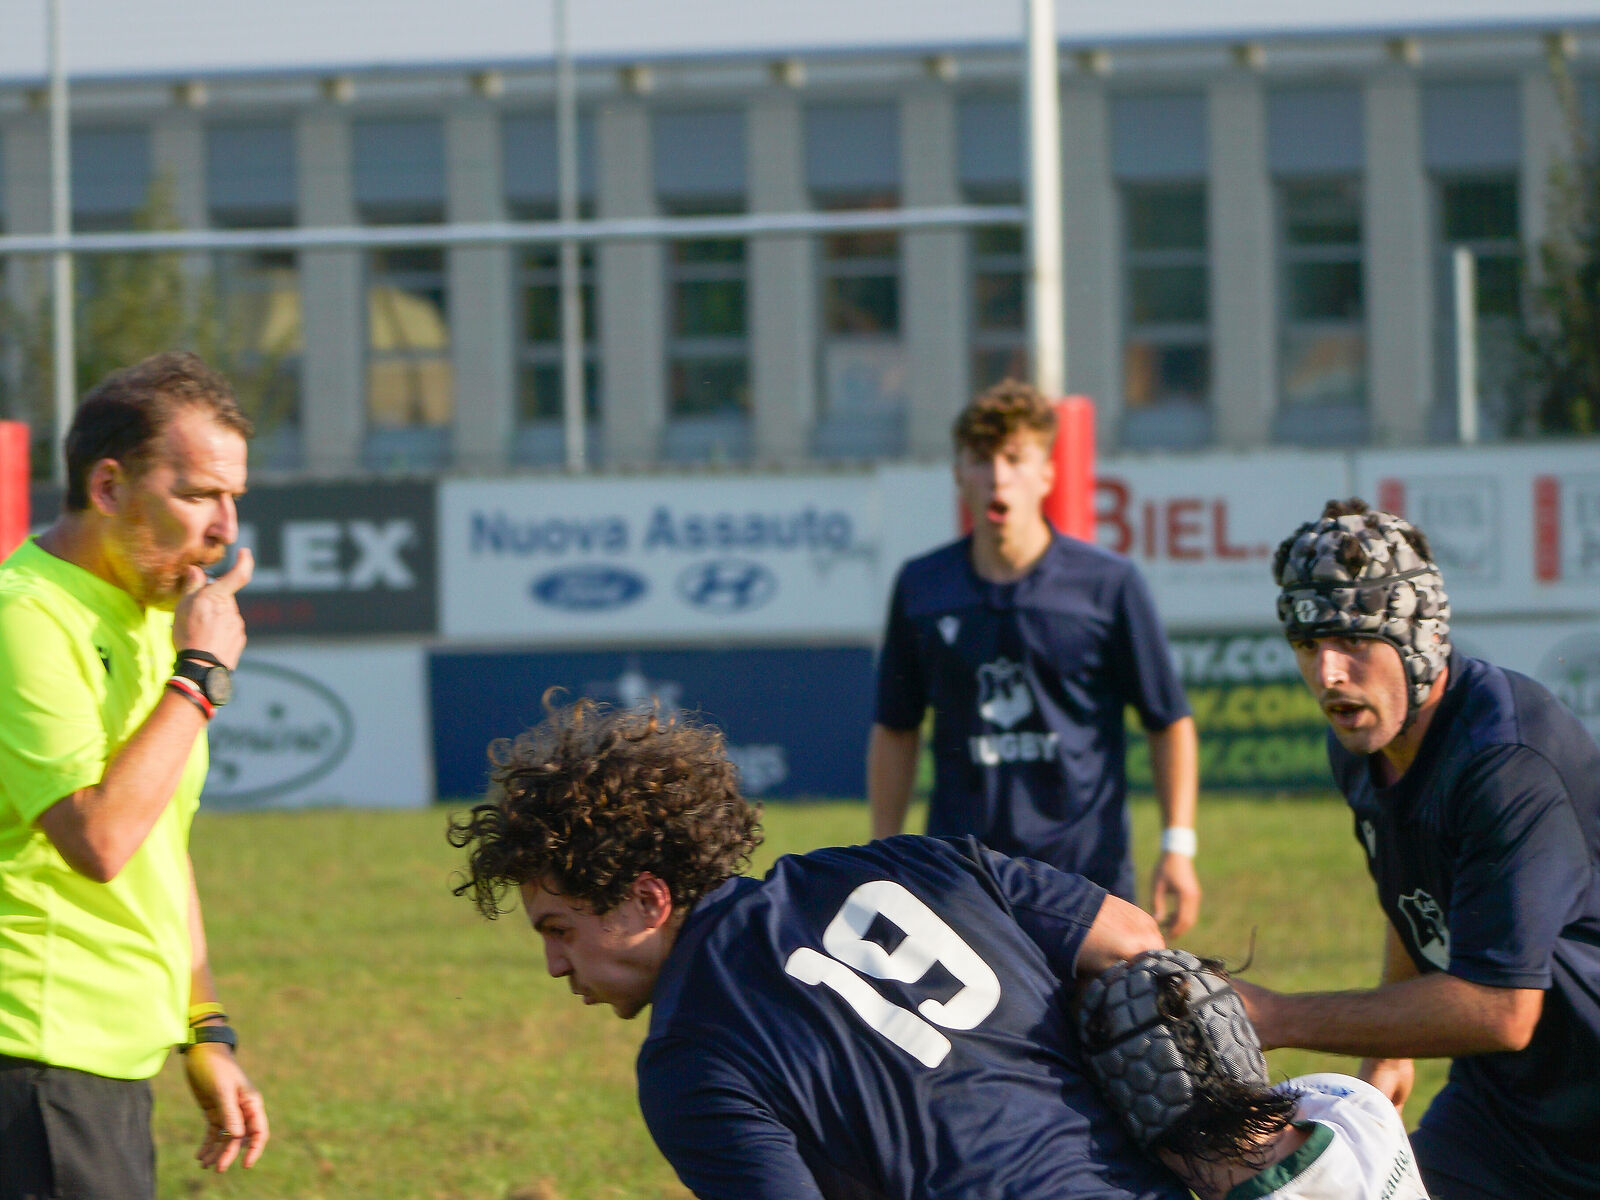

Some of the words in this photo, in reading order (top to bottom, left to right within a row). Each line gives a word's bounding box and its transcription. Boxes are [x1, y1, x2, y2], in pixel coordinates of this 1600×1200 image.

[470, 509, 629, 554] Nuova
[643, 505, 851, 551] Assauto
[784, 880, 1001, 1069] 19
